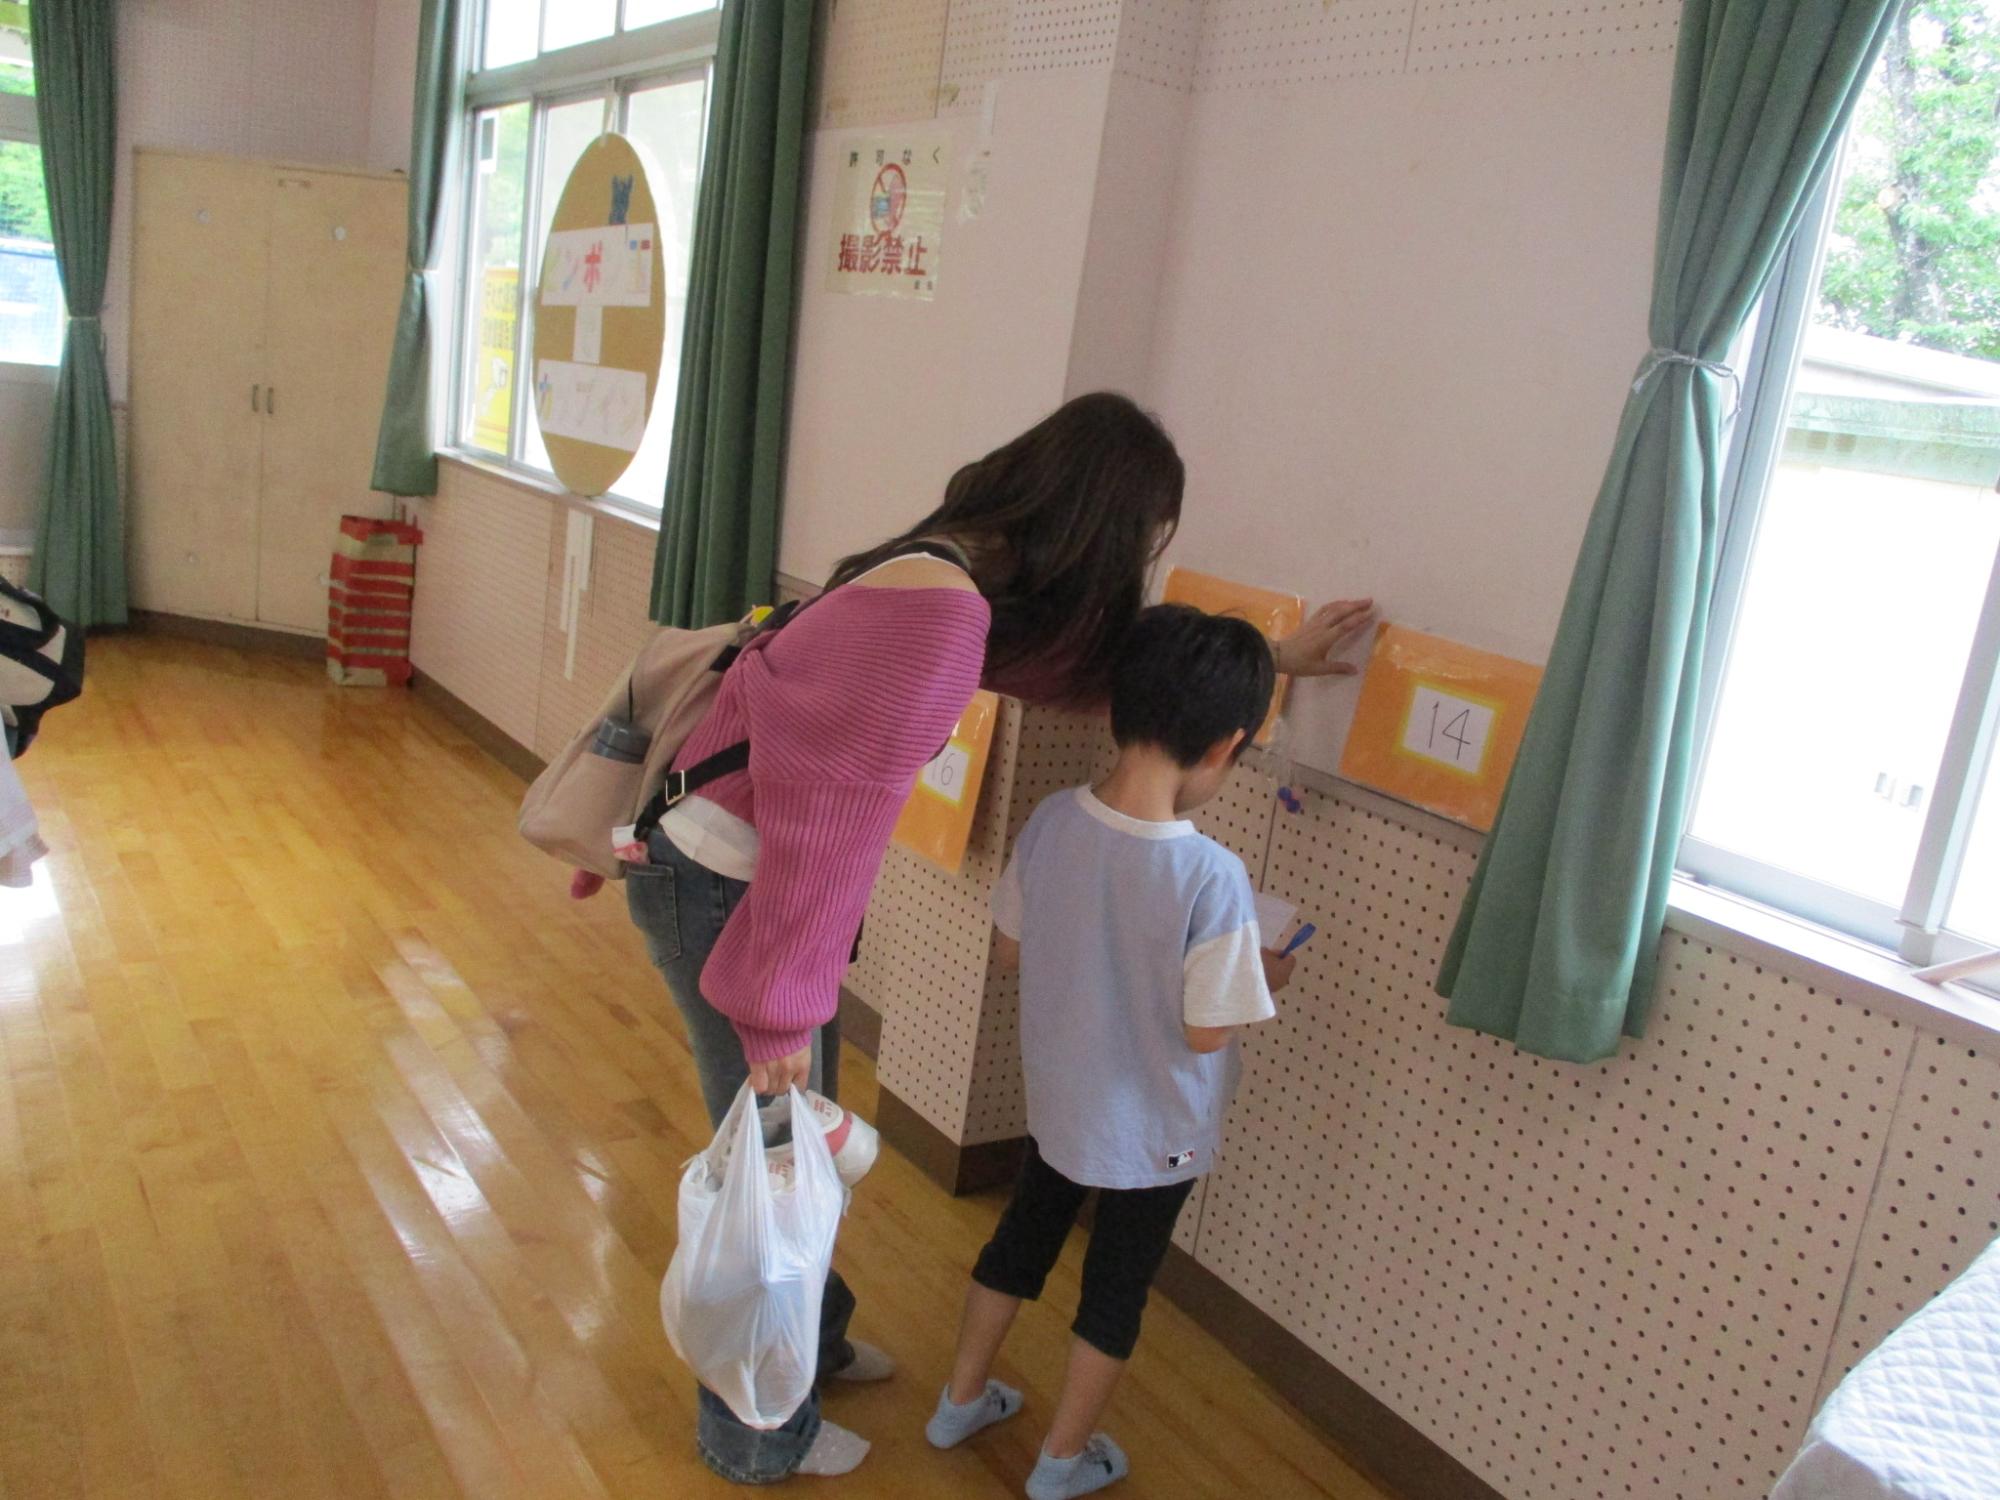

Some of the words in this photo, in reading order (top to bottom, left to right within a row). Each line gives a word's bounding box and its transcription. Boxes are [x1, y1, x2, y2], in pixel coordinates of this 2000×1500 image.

[838, 232, 928, 276] 撮影禁止
[1427, 700, 1472, 761] 14
